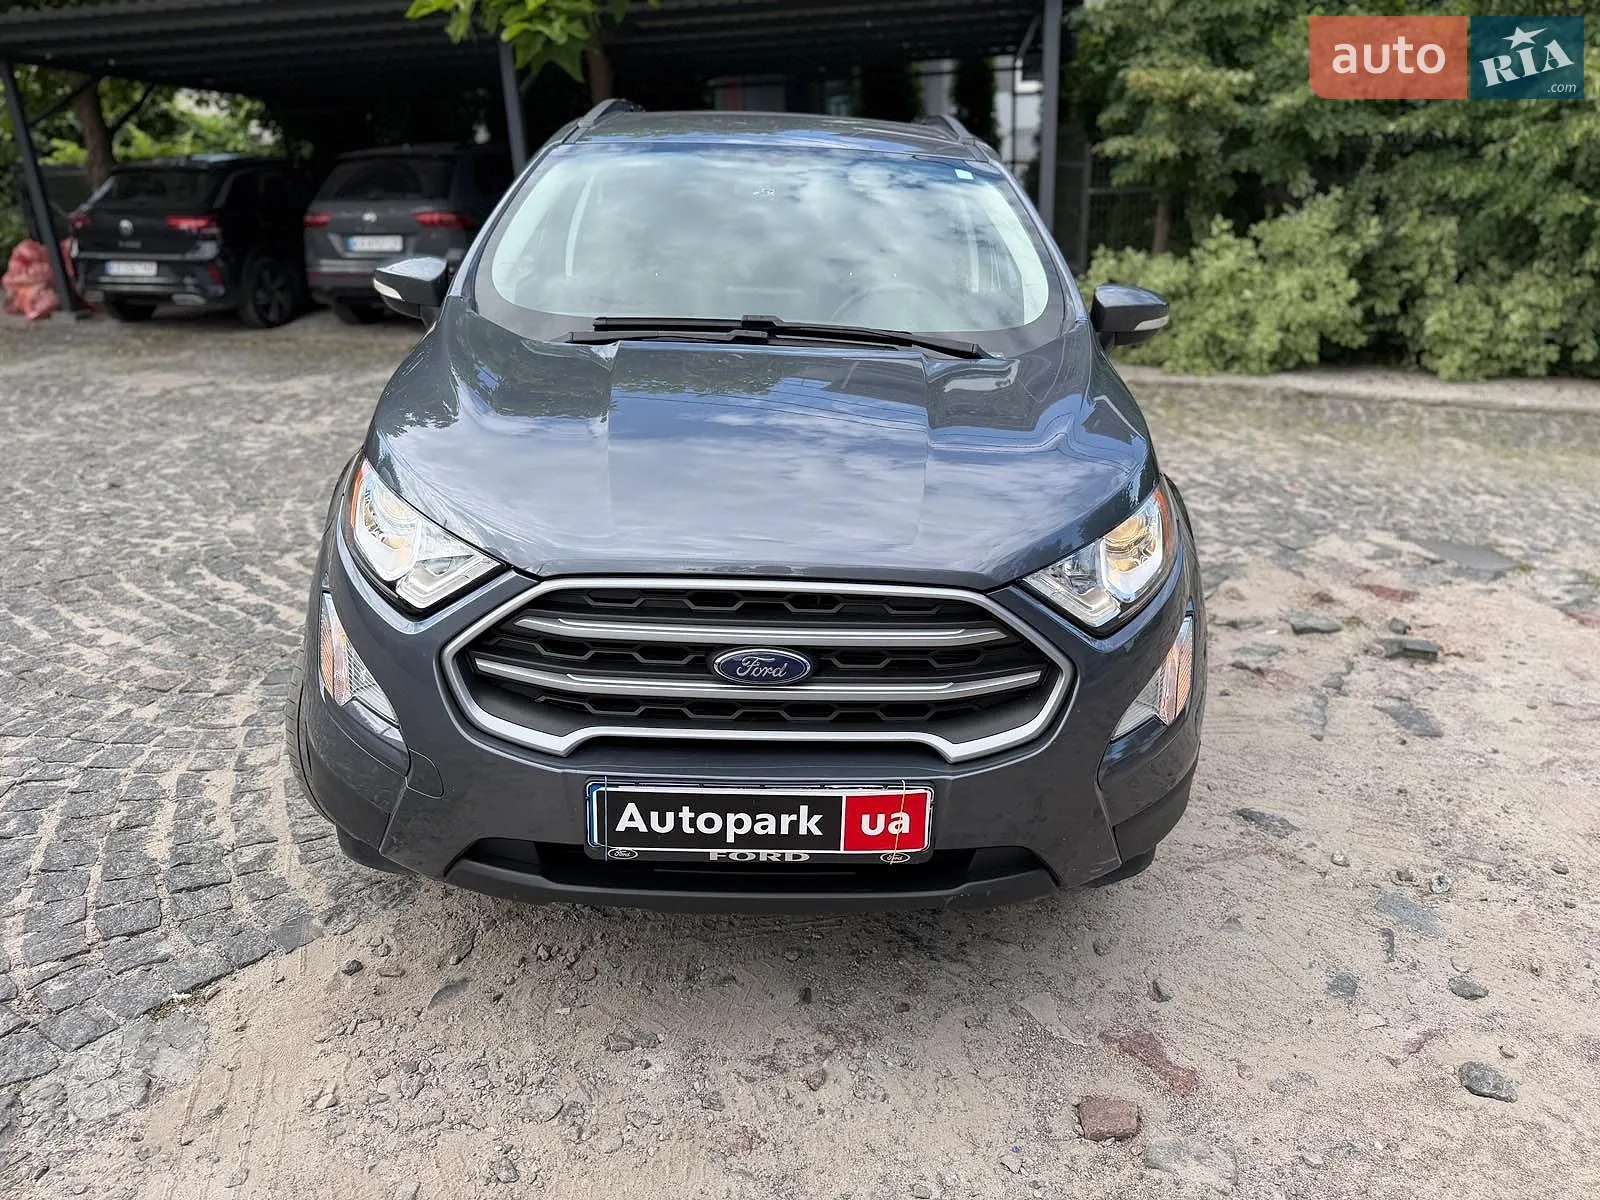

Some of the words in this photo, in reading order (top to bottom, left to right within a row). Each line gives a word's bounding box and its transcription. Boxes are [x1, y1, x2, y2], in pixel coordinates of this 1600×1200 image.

[736, 656, 788, 678] Ford
[615, 802, 823, 843] Autopark
[861, 811, 911, 836] ua
[709, 851, 810, 863] FORD
